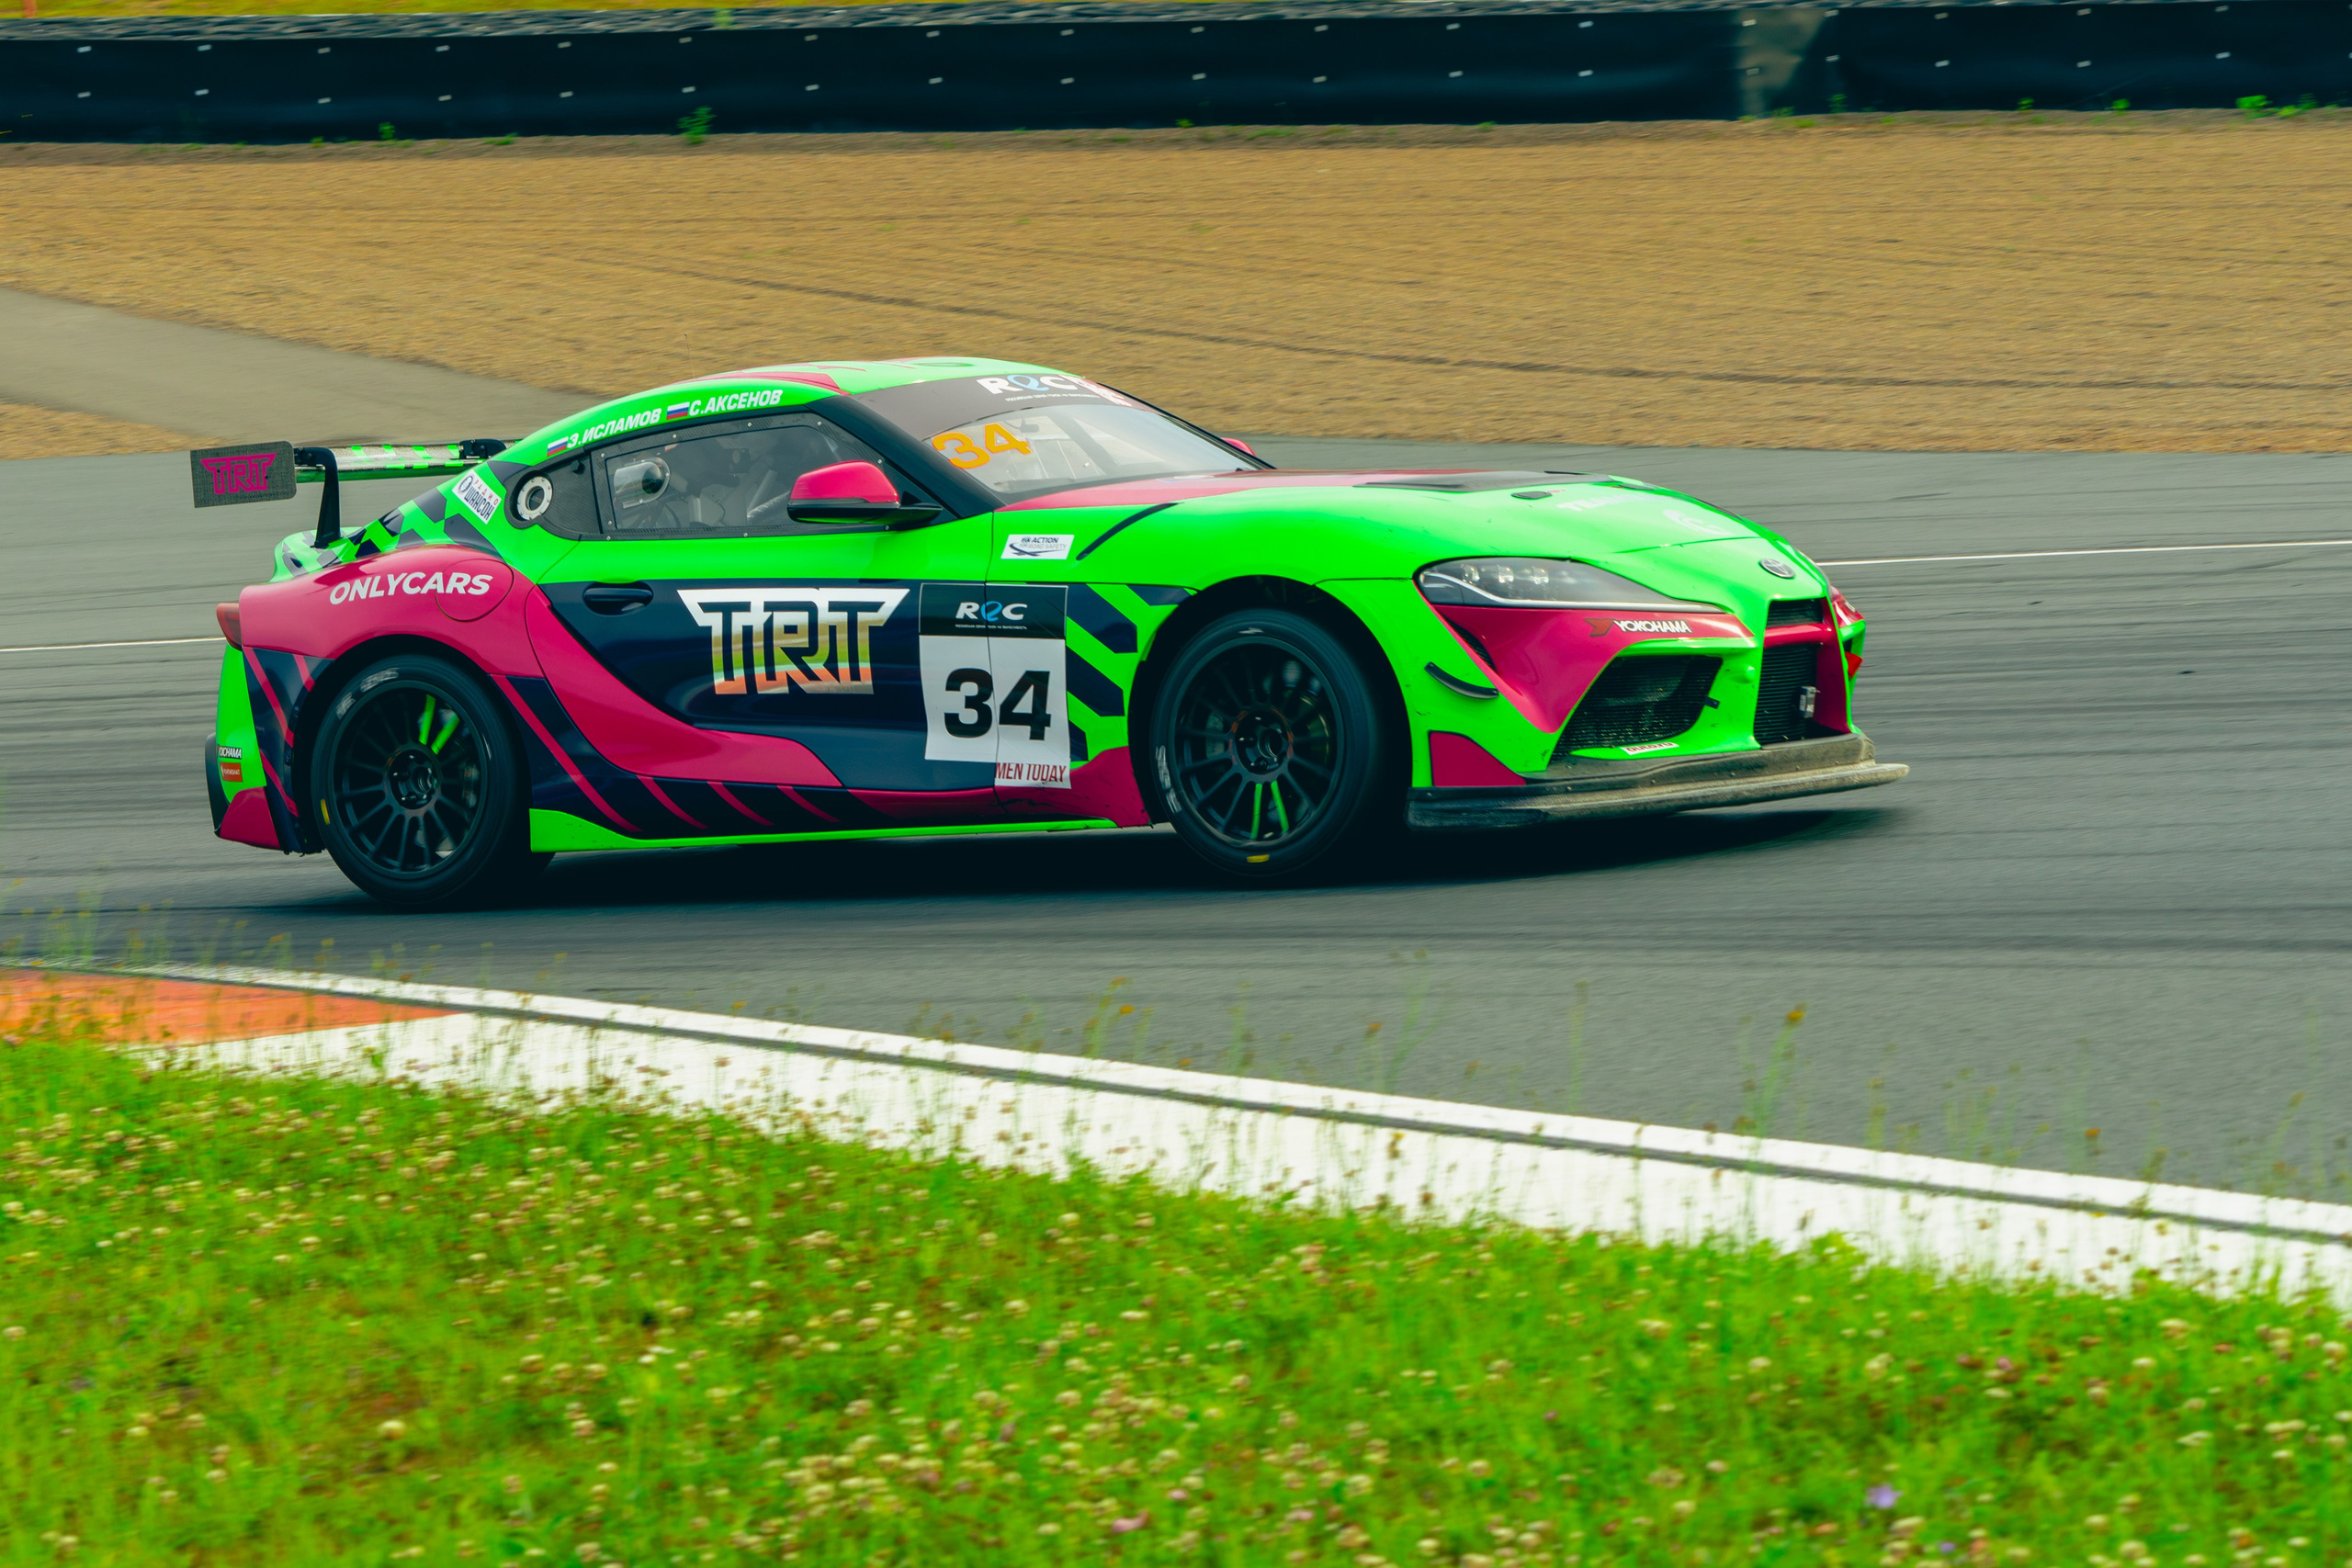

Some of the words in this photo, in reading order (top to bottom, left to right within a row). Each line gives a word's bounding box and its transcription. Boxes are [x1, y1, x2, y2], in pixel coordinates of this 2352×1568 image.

[689, 389, 784, 416] С.АКСЕНОВ
[567, 408, 662, 449] Э.ИСЛАМОВ
[932, 423, 1033, 469] 34
[200, 453, 277, 495] TRT
[464, 486, 495, 521] ШАНСОН
[329, 571, 493, 605] ONLYCARS
[676, 587, 910, 695] TRT
[1612, 619, 1693, 634] YOKOHAMA
[944, 667, 1052, 741] 34
[995, 761, 1023, 781] MEN
[1025, 763, 1067, 783] TODAY
